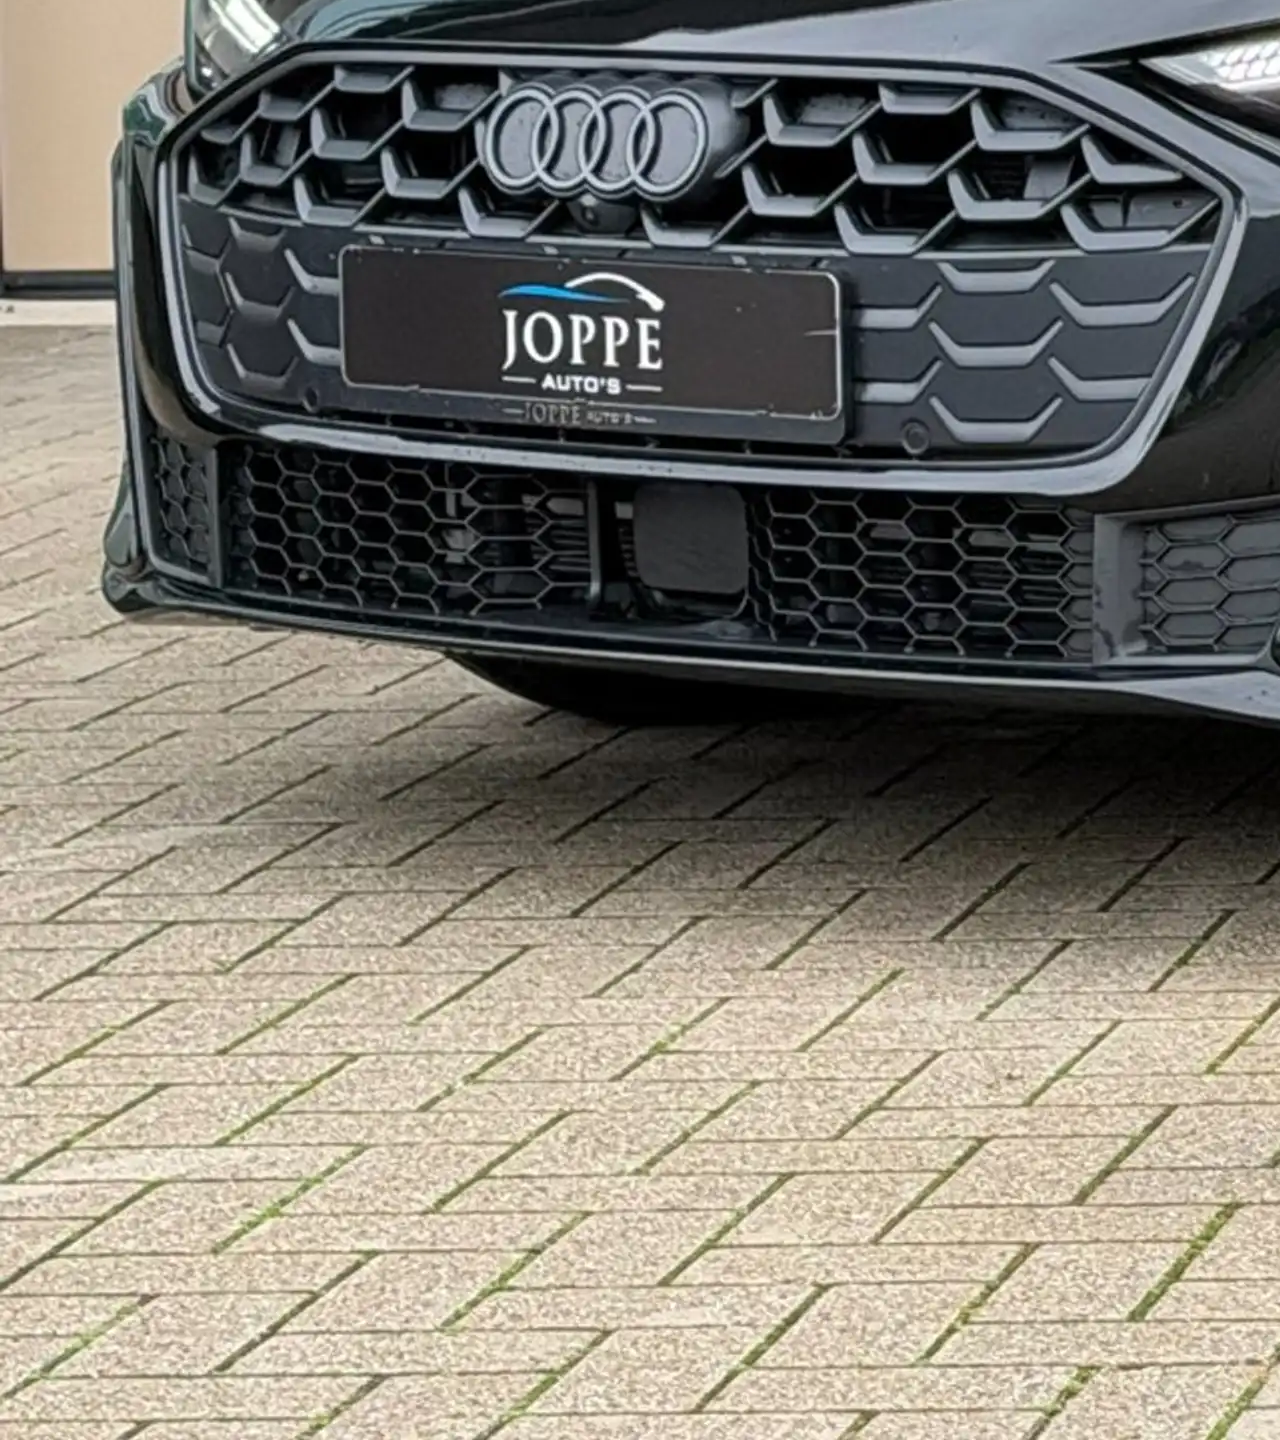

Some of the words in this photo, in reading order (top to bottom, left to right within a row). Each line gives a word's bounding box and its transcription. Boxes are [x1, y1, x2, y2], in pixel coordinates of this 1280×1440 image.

[502, 310, 664, 371] JOPPE
[541, 374, 622, 394] AUTO'S
[524, 402, 580, 425] JOPPE
[587, 408, 632, 424] AUTO'S
